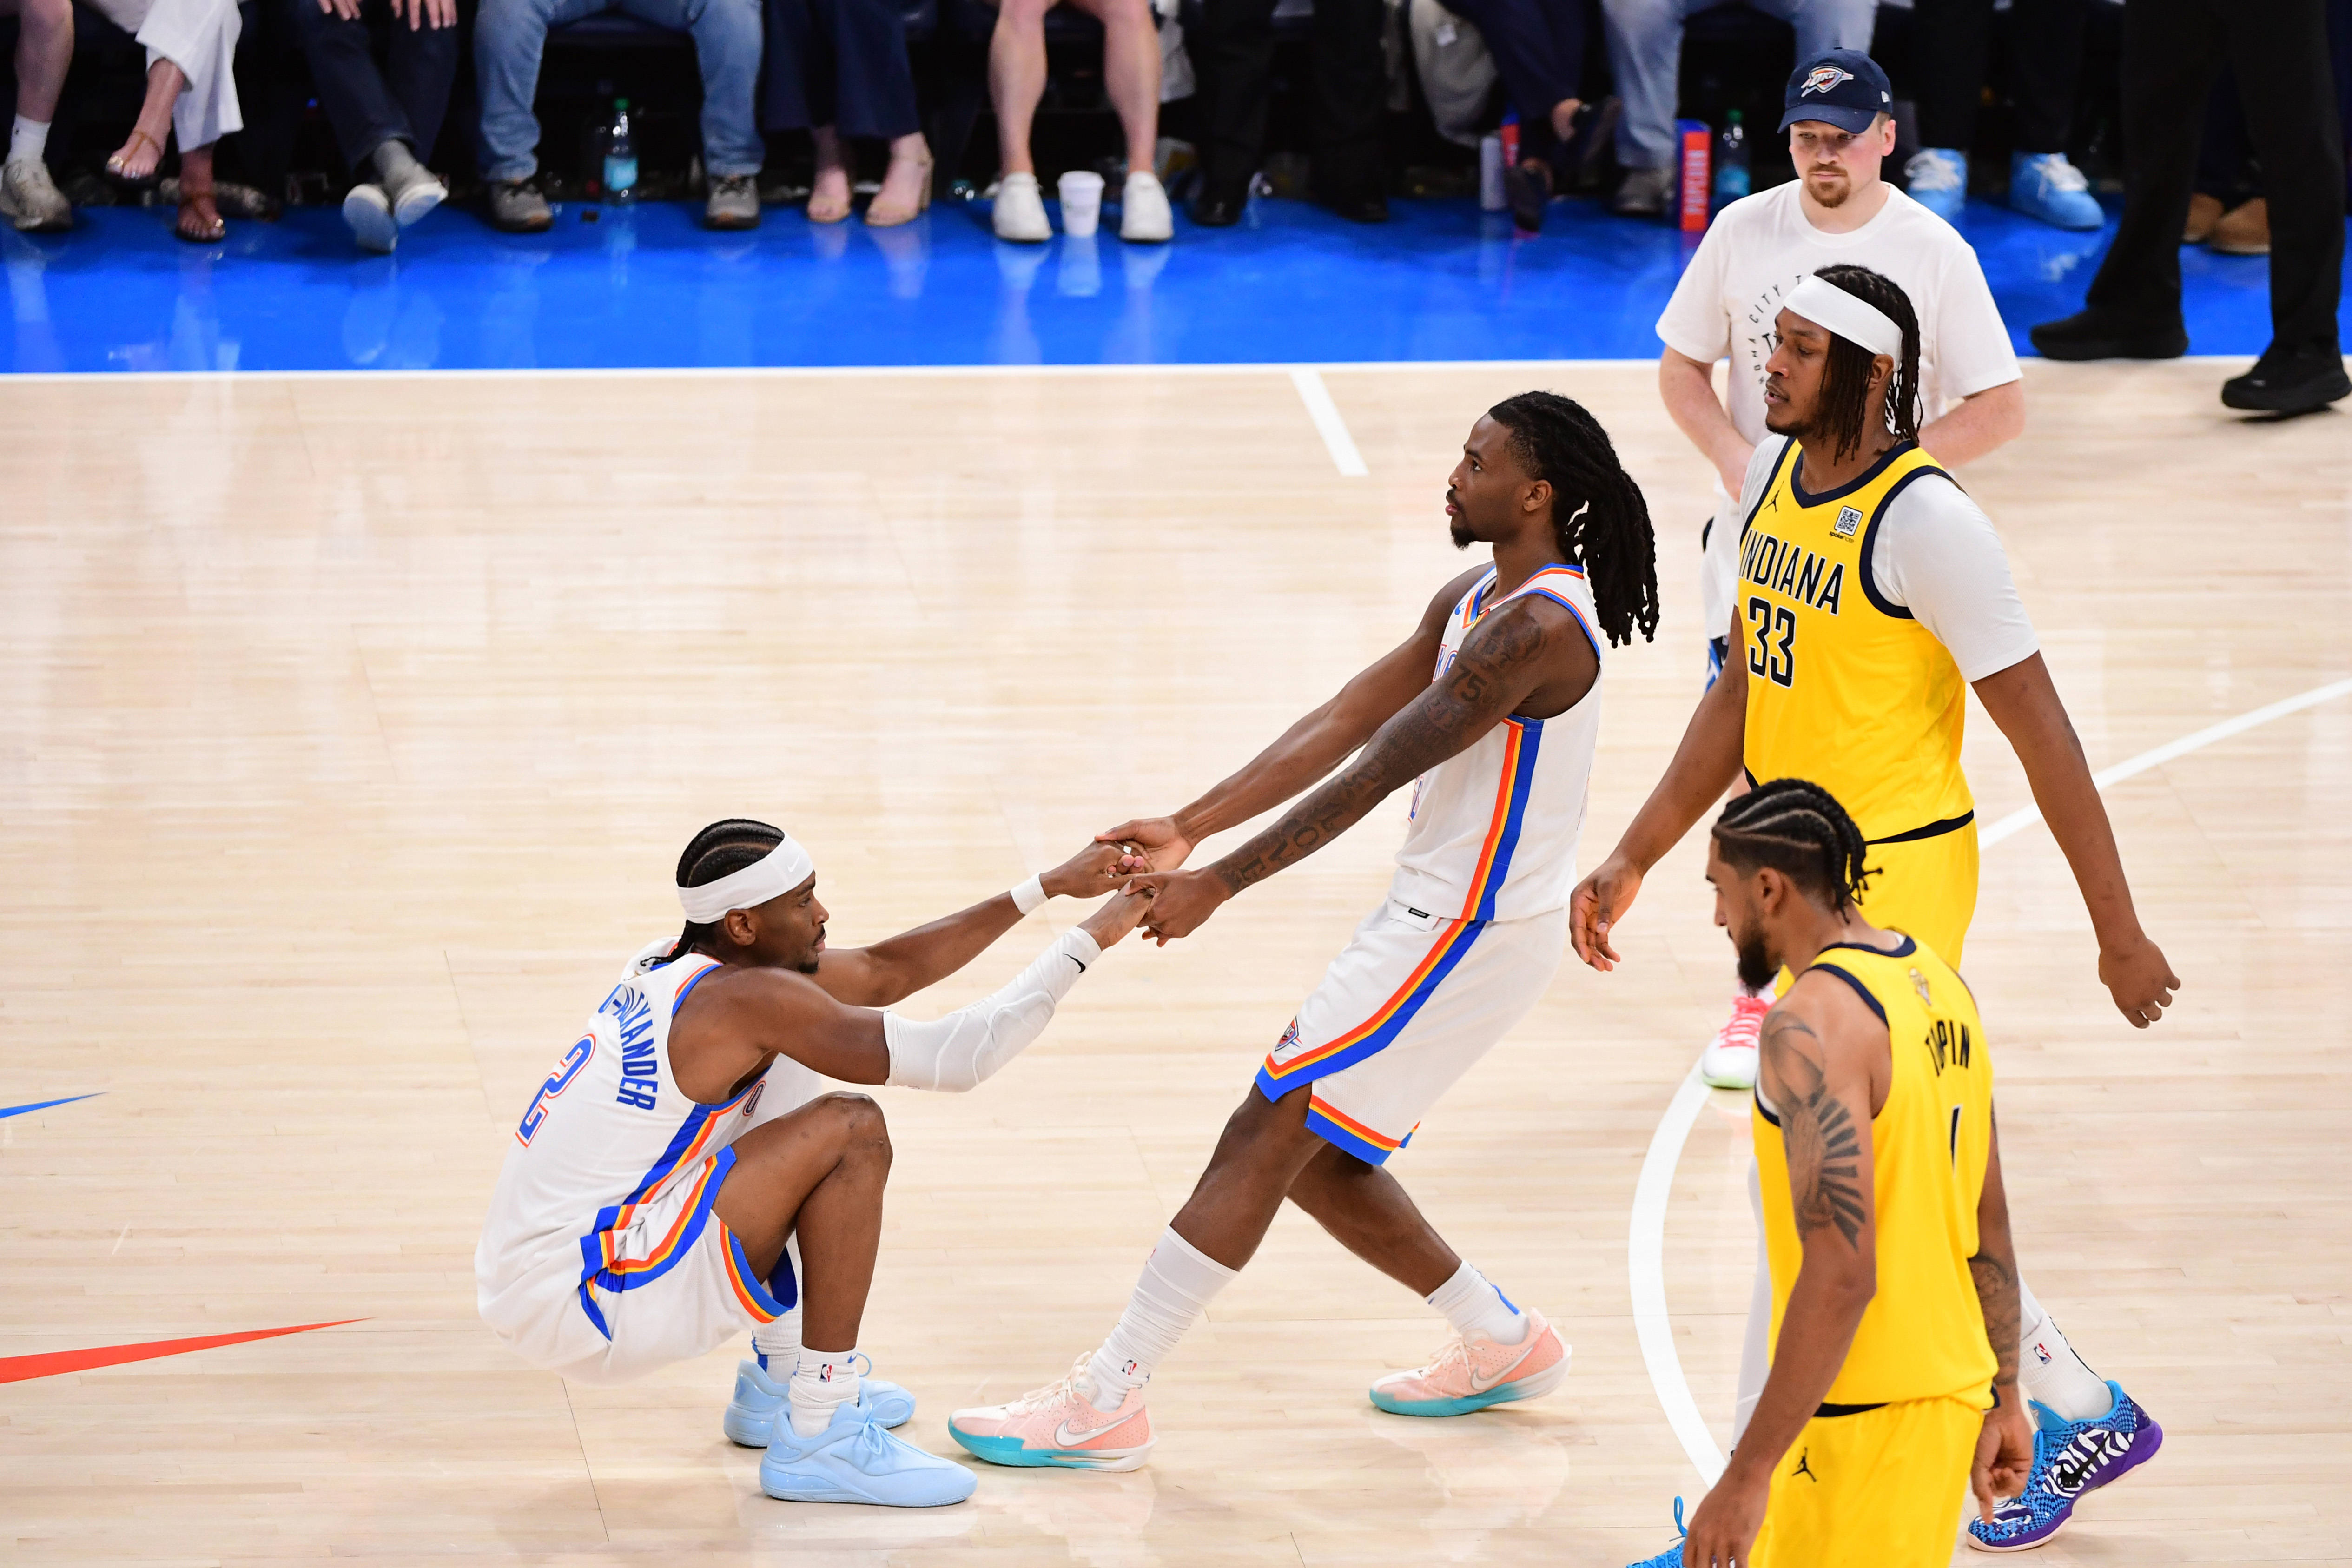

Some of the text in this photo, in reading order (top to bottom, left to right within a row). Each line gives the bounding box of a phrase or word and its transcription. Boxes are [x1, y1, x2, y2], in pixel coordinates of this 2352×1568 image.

[1749, 284, 1781, 324] CITY
[1739, 528, 1845, 616] INDIANA
[1829, 531, 1855, 544] spokenote
[1748, 595, 1797, 689] 33
[1451, 662, 1488, 702] 75
[515, 1032, 597, 1149] 2
[1949, 1103, 1964, 1179] 1
